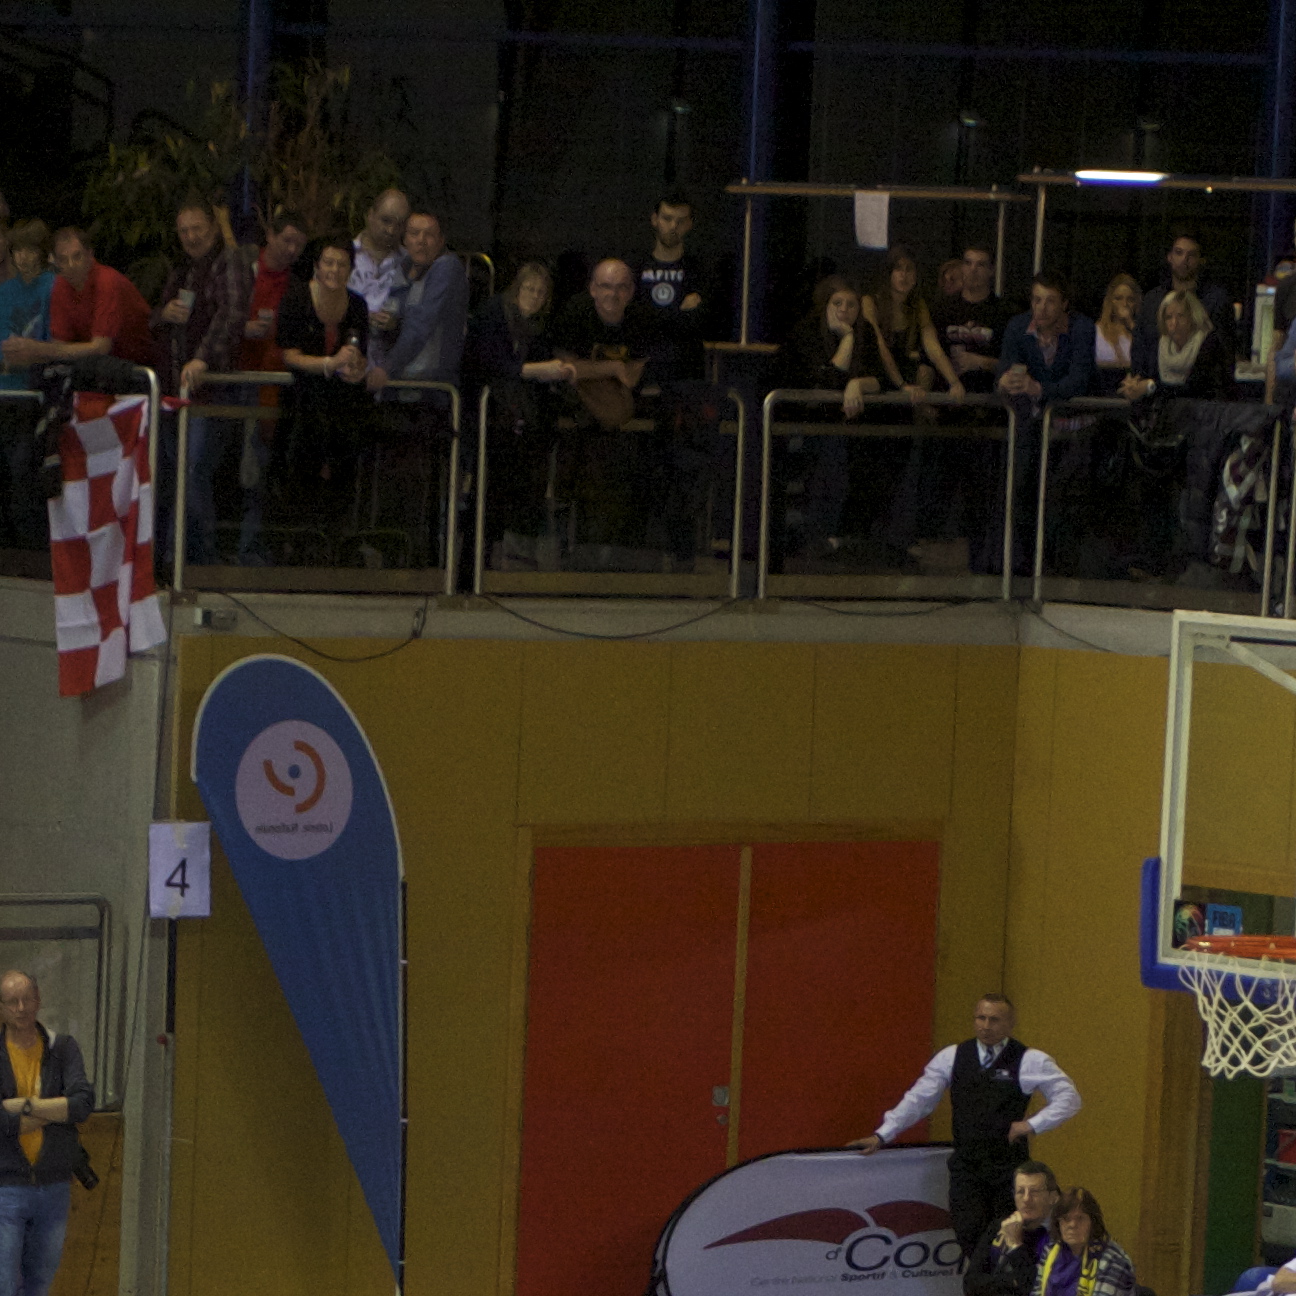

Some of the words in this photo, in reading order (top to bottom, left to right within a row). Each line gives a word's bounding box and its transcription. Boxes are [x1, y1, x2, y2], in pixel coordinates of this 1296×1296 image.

[165, 858, 190, 897] 4
[840, 1271, 886, 1283] Sportif
[901, 1268, 953, 1279] Culturel
